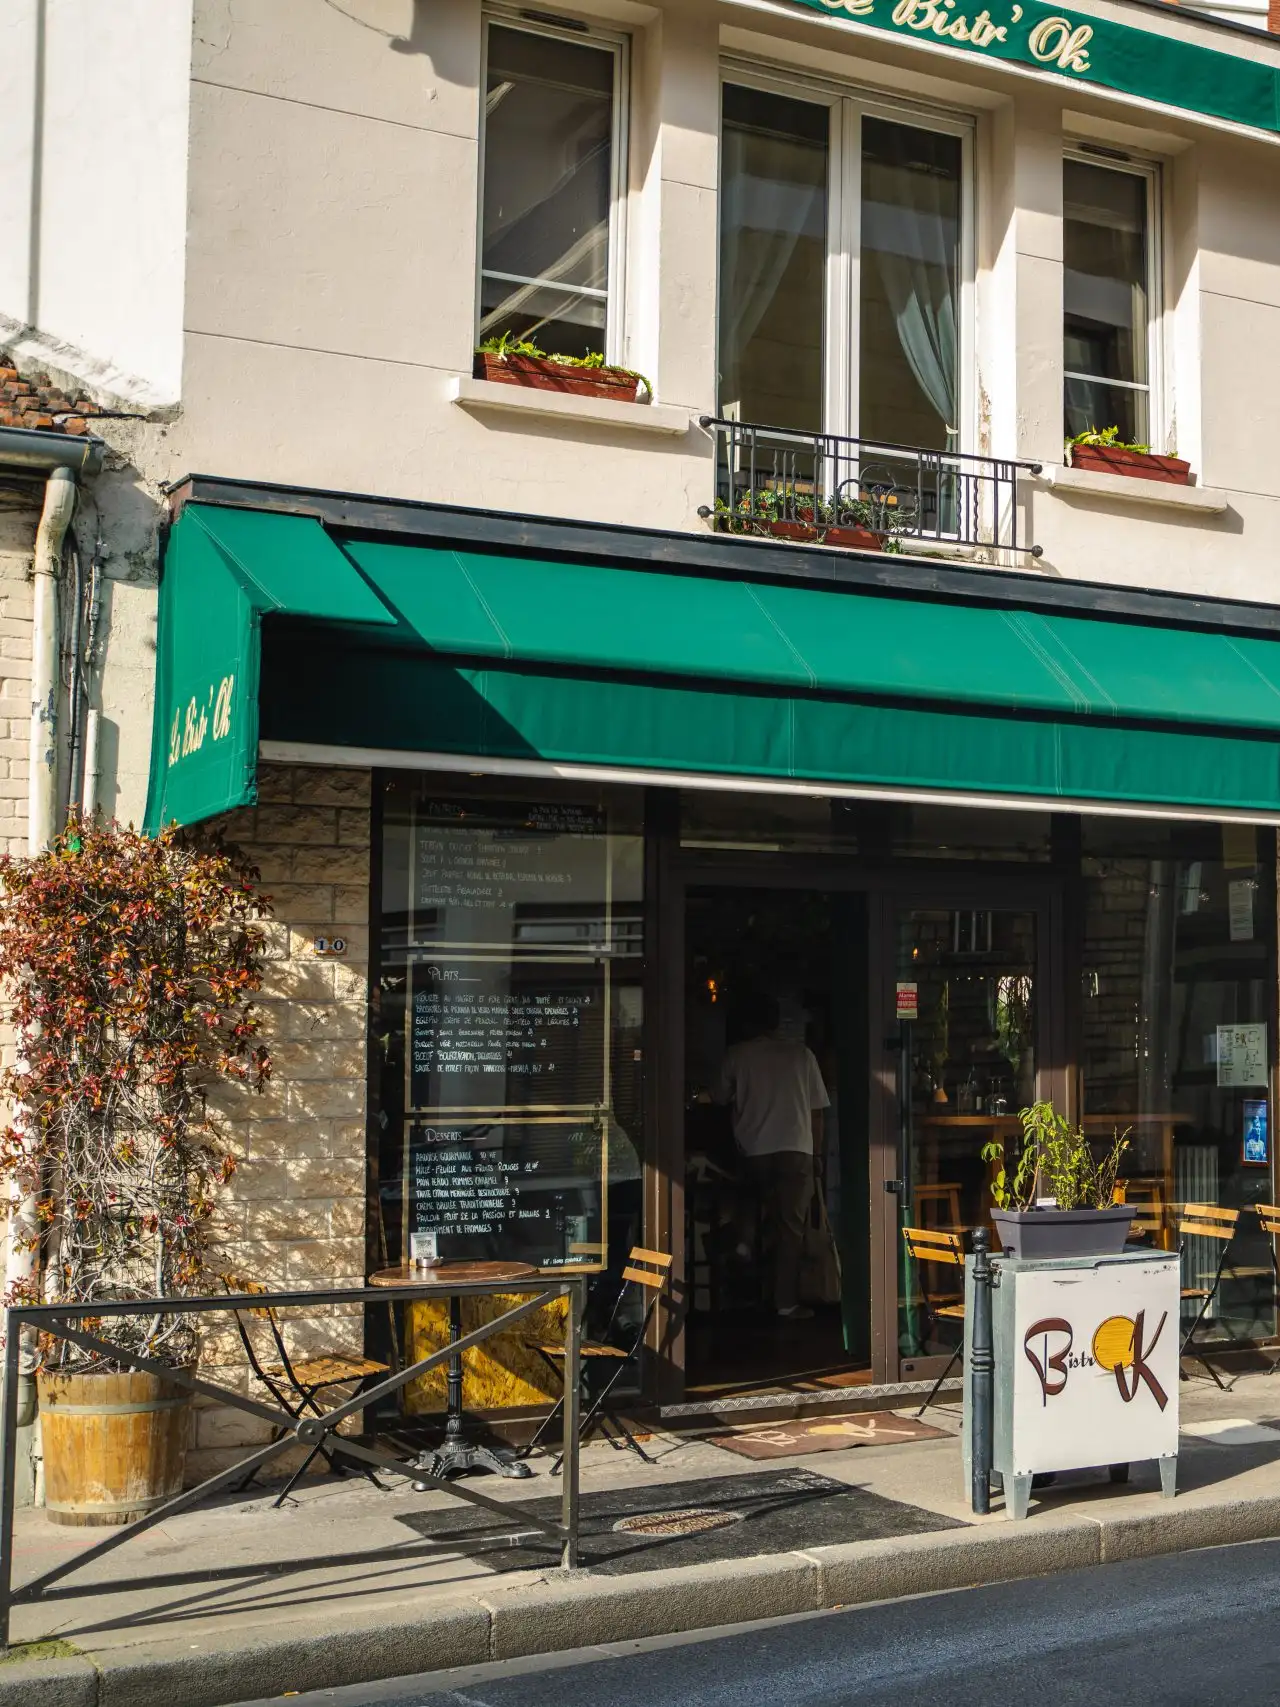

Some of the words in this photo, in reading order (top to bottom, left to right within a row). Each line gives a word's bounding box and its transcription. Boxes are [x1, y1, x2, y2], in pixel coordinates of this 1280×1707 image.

[1028, 16, 1092, 73] Ok
[169, 707, 181, 768] Le
[213, 674, 234, 741] Ok
[316, 939, 344, 951] 10
[428, 966, 459, 981] PLATS
[425, 1128, 462, 1142] DESSERTS
[482, 1209, 506, 1221] PASSION
